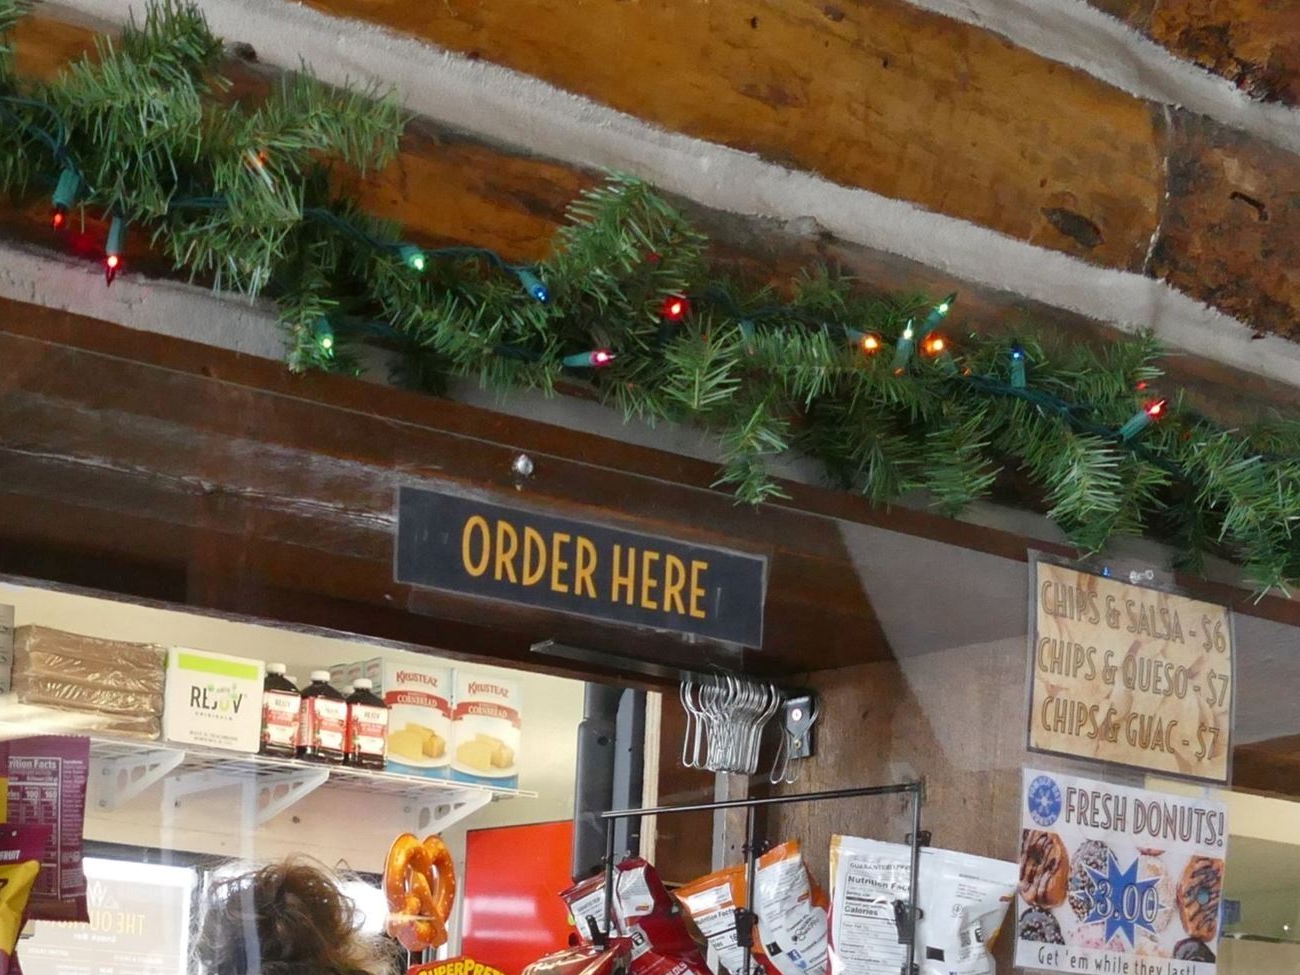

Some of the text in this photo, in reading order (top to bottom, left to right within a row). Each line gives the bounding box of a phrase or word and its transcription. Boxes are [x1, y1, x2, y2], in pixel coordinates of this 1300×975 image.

[461, 515, 709, 620] ORDER HERE
[1041, 580, 1226, 653] CHIPS & SALSA $6
[396, 670, 438, 687] KRUSTEAZ
[468, 681, 508, 698] KRUSTEAZ
[1037, 636, 1229, 709] CHIPS & QUESO $7
[1041, 695, 1219, 762] CHIPS & GUAC $7
[1066, 786, 1126, 832] FRESH
[1133, 797, 1224, 847] DONUTS!
[1038, 945, 1058, 966] Get
[1065, 946, 1088, 971] 'em
